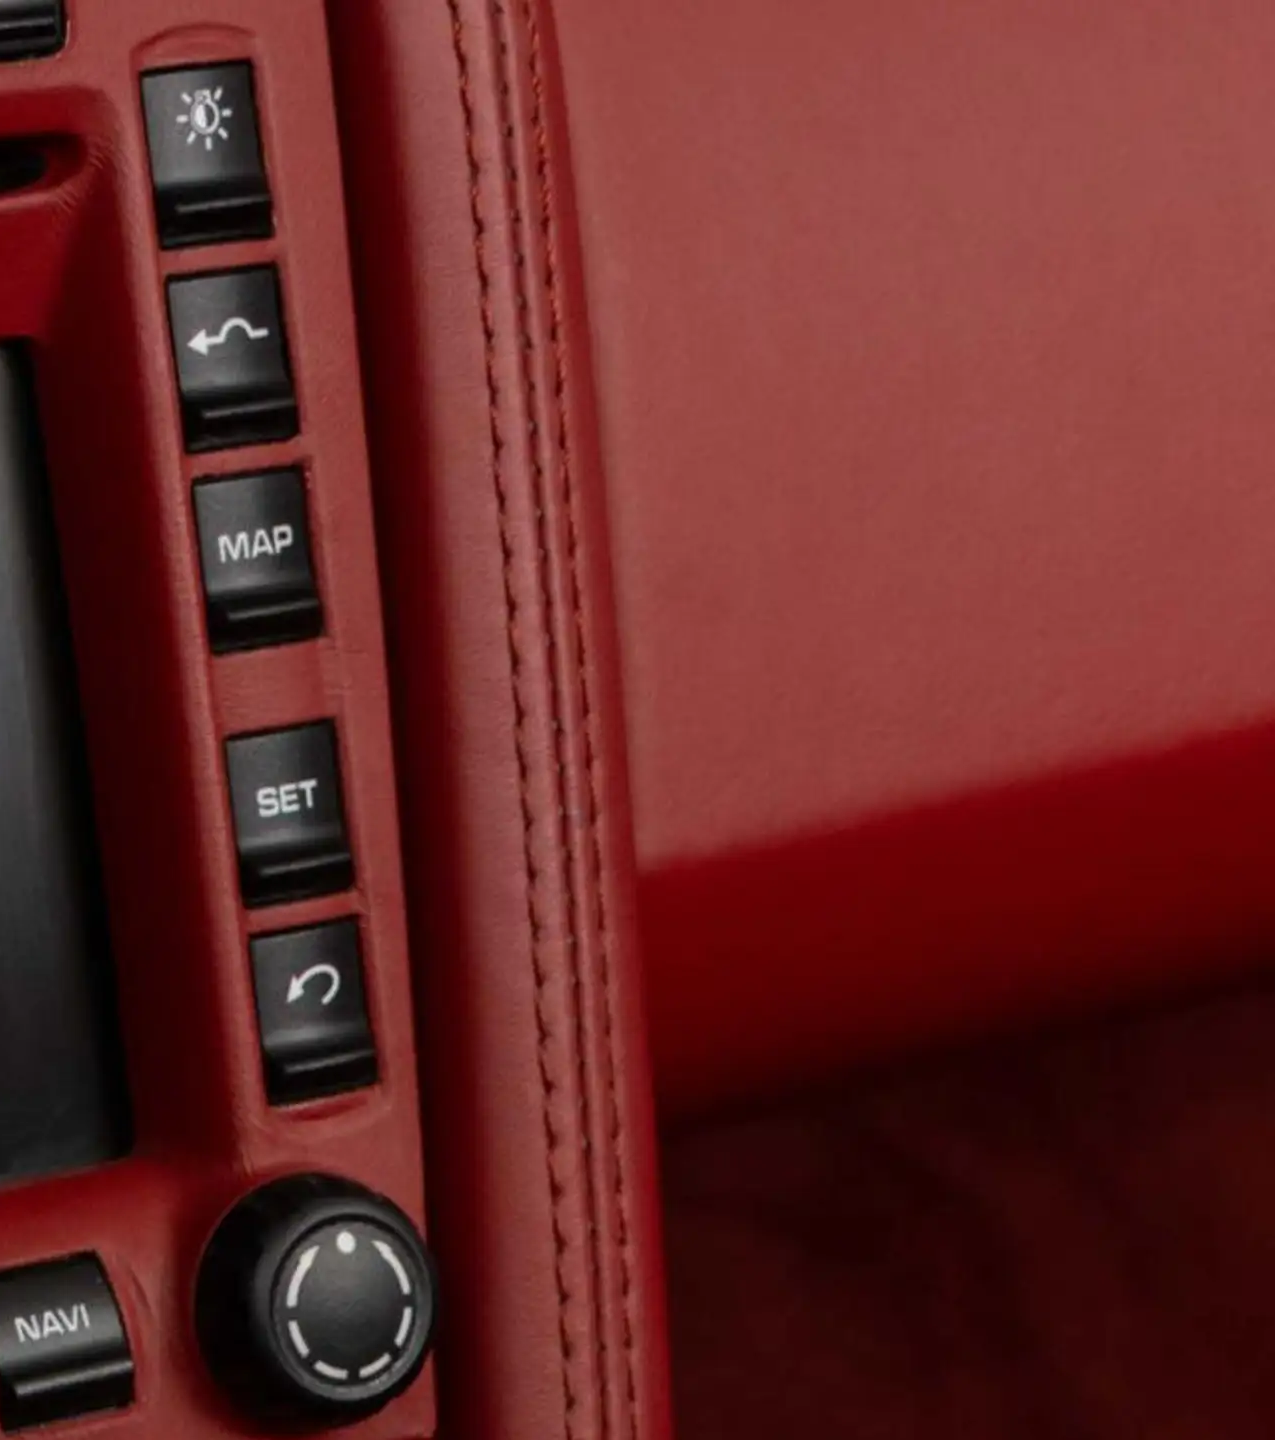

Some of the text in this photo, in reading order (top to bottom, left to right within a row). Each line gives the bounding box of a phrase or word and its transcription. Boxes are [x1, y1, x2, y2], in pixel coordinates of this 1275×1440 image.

[217, 524, 293, 564] MAP
[255, 779, 317, 818] SET
[14, 1304, 92, 1344] NAVI
